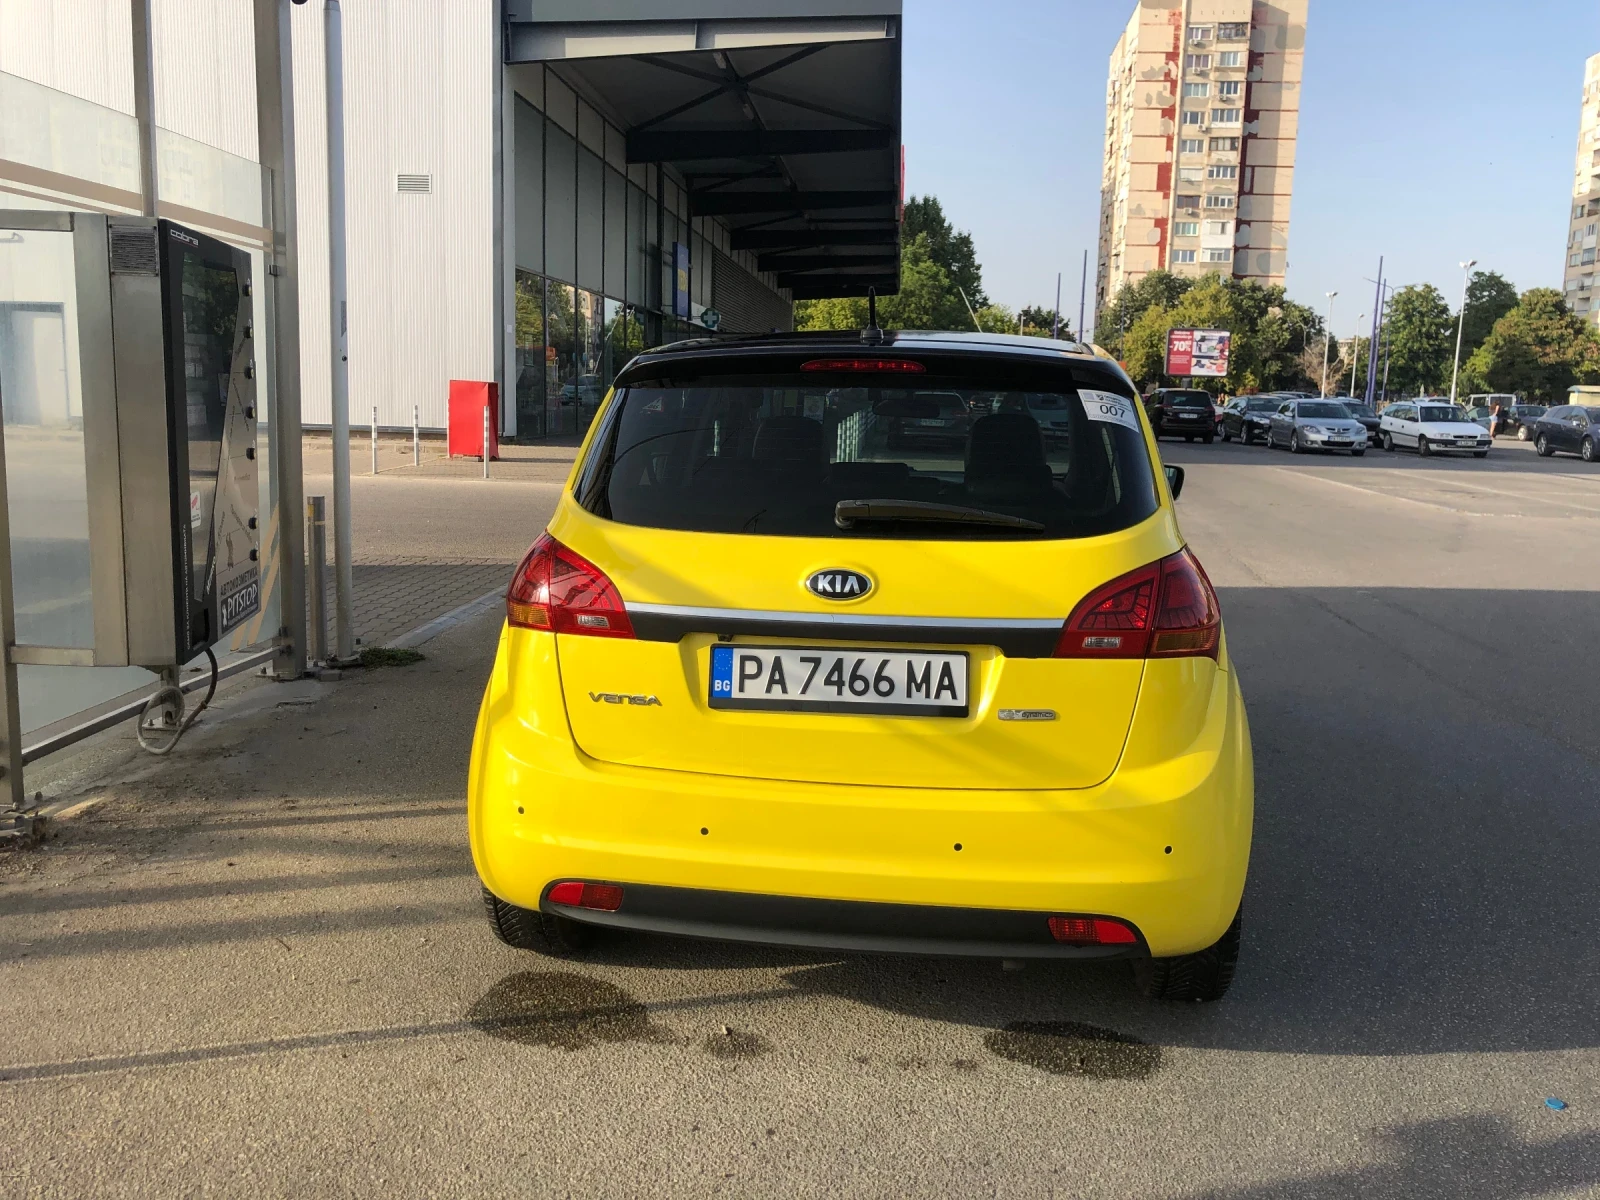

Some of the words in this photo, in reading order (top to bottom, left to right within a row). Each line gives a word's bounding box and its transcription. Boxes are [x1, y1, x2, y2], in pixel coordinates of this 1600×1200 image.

[170, 229, 199, 246] cobra
[1100, 404, 1125, 418] 007
[818, 575, 860, 593] KIA
[227, 583, 258, 619] PITSTOP
[714, 680, 731, 692] BG
[738, 655, 788, 694] PA
[799, 657, 895, 697] 7466
[906, 660, 958, 700] MA
